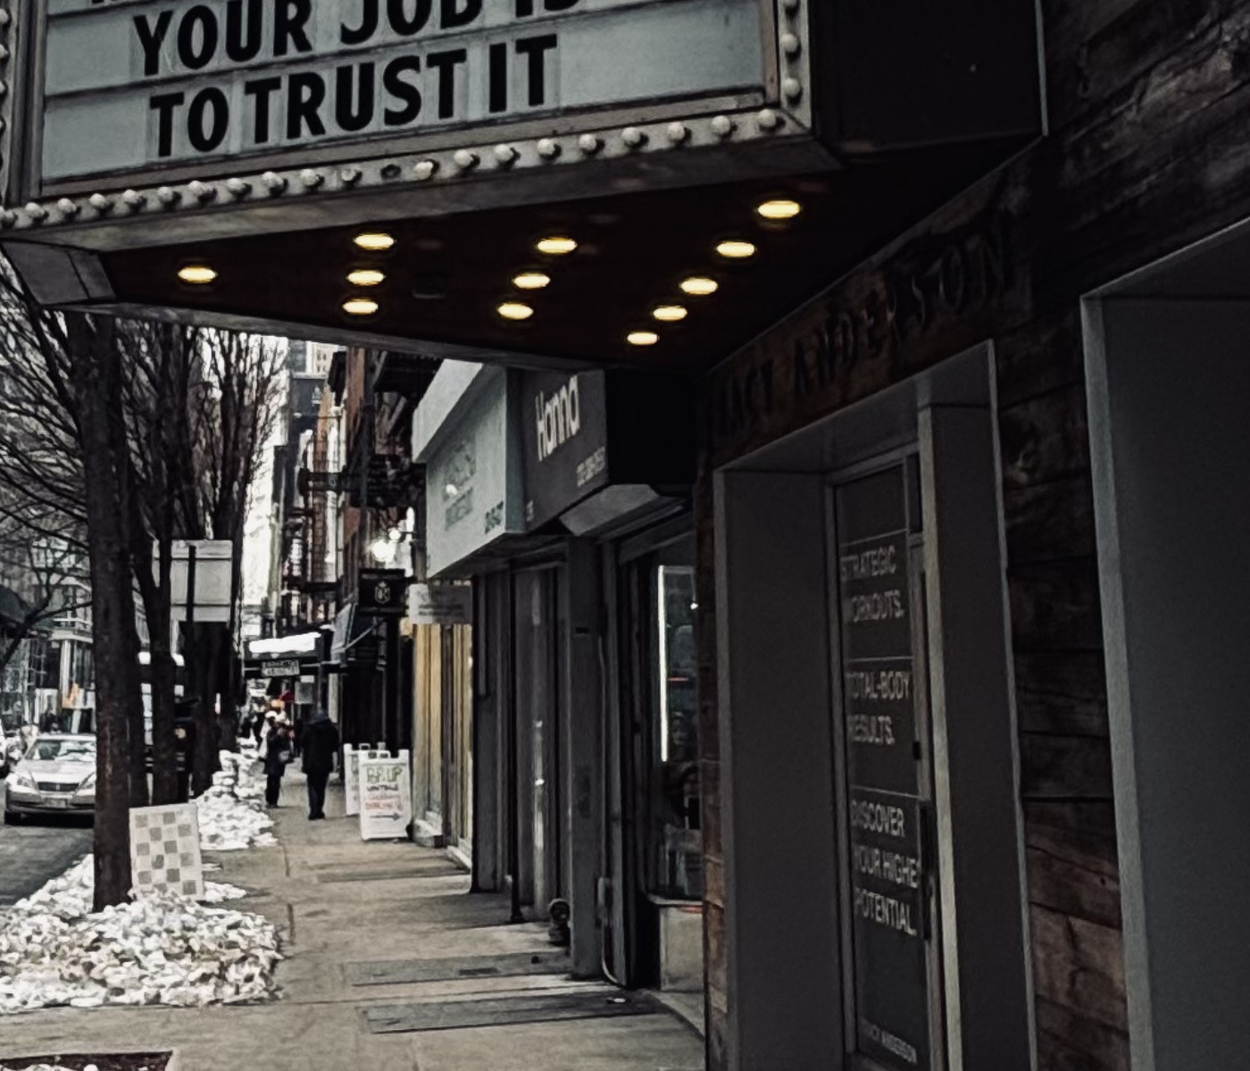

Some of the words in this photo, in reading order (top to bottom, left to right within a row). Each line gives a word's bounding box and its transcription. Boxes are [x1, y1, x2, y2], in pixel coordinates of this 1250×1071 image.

[150, 87, 230, 158] TO
[244, 48, 468, 146] TRUST
[487, 33, 559, 114] IT
[534, 374, 581, 462] Hanna
[846, 589, 905, 623] ORKOUTS.
[850, 799, 906, 838] DISCOVER
[881, 852, 920, 889] HIGHE
